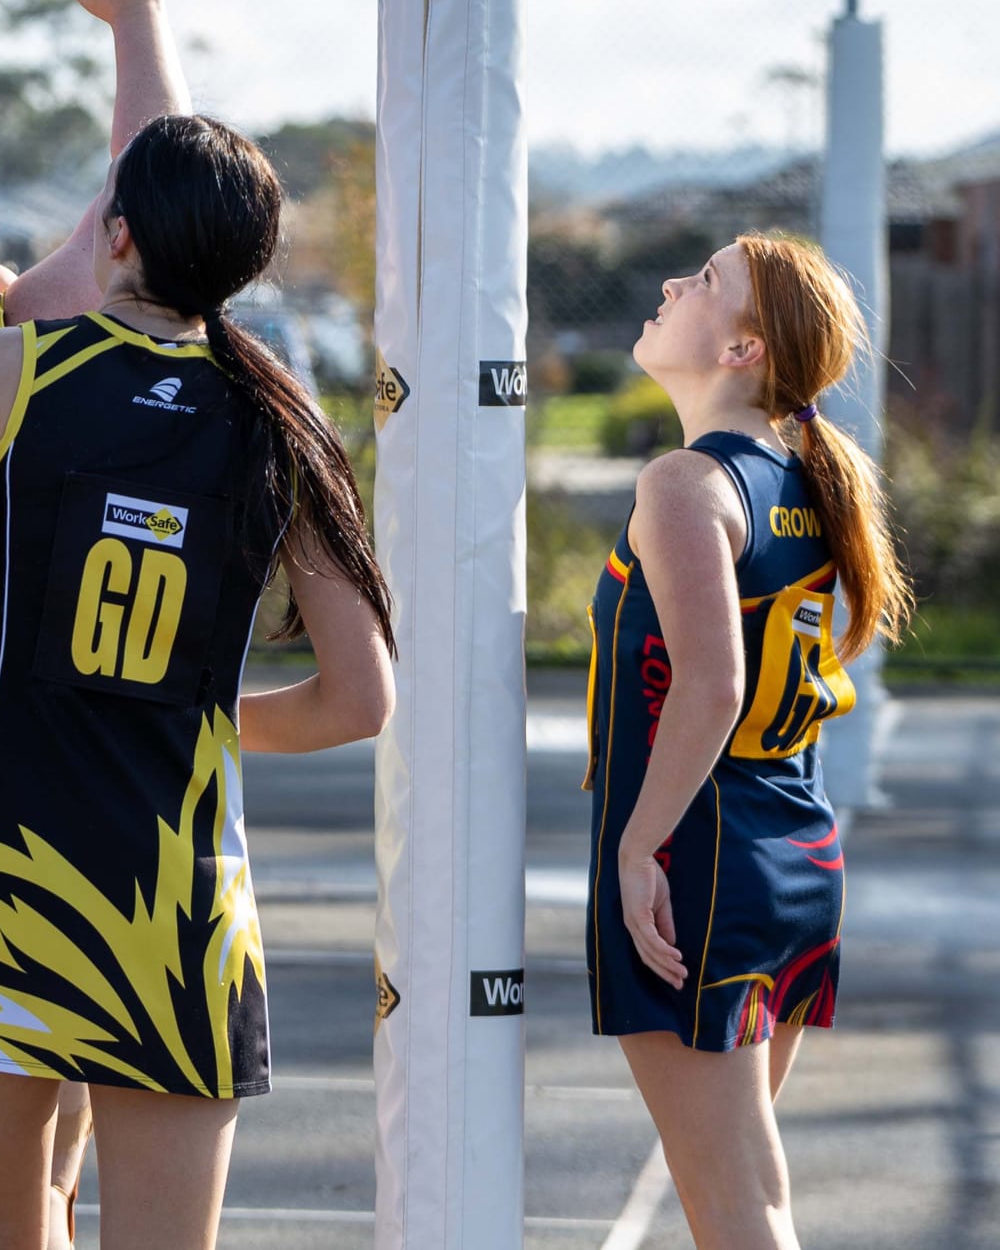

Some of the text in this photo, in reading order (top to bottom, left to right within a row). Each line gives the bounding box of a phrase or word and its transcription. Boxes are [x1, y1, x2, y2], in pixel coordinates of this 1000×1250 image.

[132, 396, 197, 414] ENERGETIC
[769, 505, 821, 538] CROW
[71, 537, 187, 684] GD
